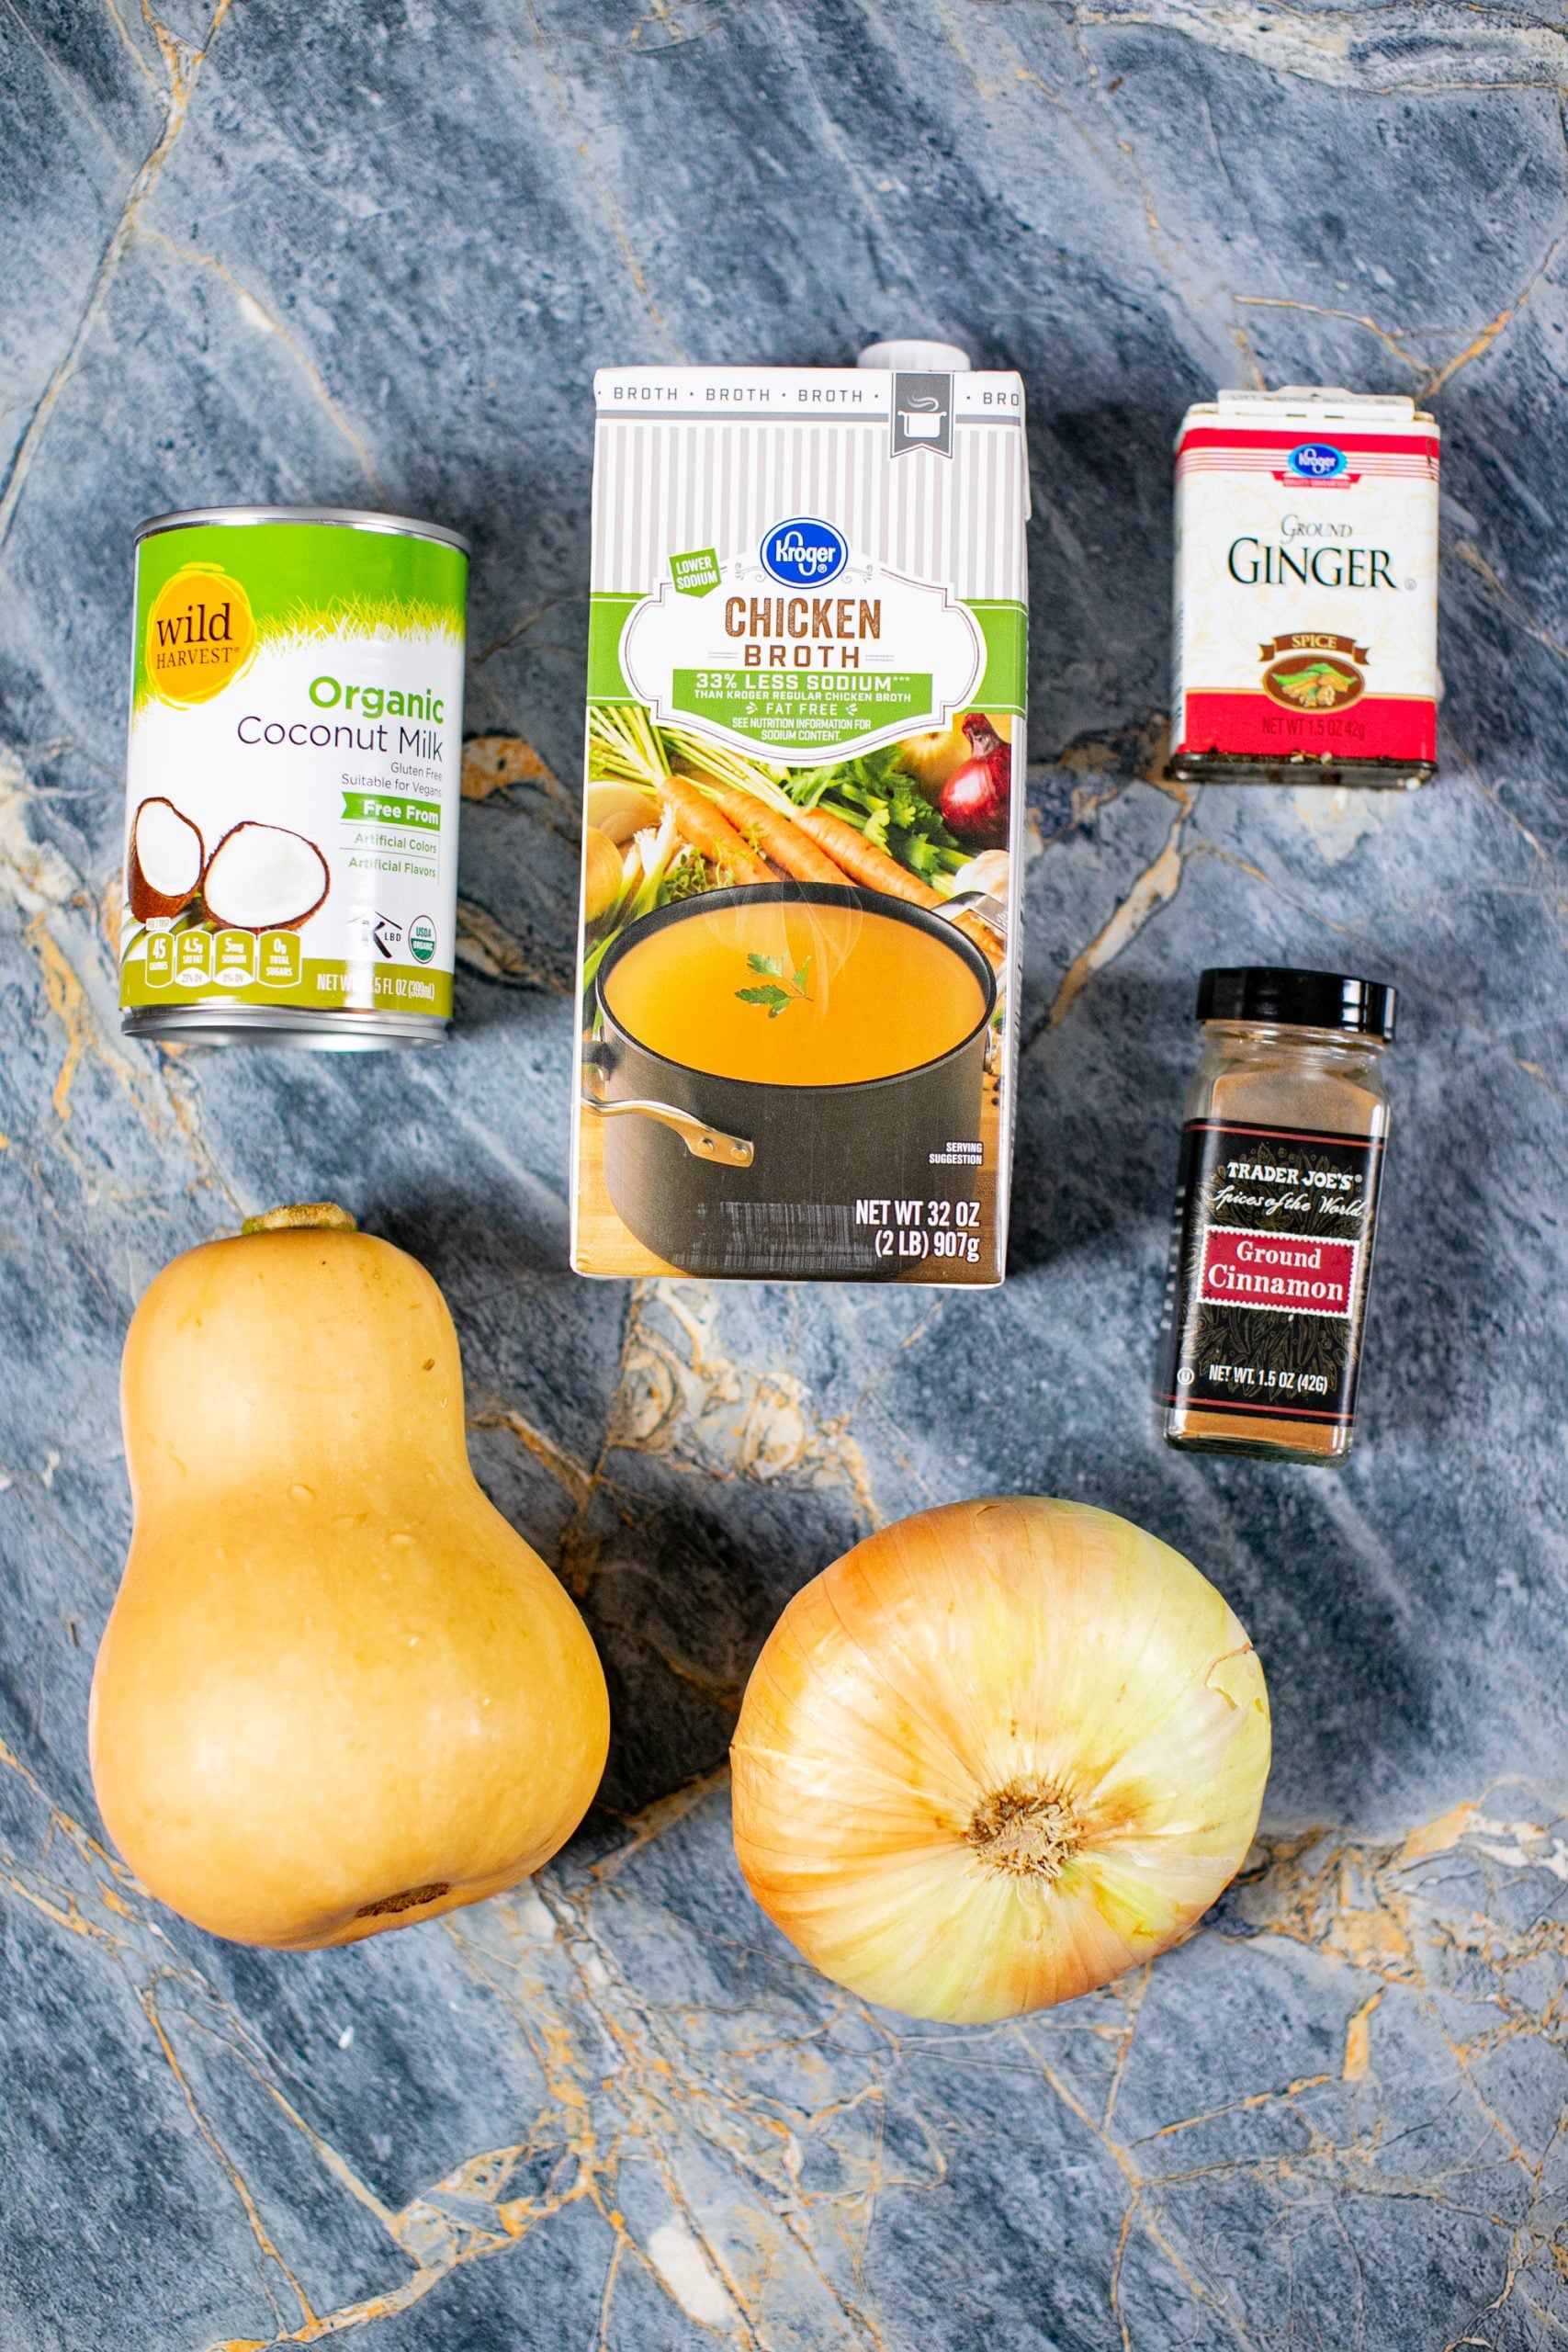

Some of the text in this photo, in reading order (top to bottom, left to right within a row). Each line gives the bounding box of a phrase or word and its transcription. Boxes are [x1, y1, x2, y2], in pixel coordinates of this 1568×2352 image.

[614, 386, 678, 401] BROTH
[705, 388, 771, 401] BROTH
[797, 389, 863, 402] BROTH
[1298, 447, 1337, 474] Kroger
[1280, 514, 1353, 544] GROUND
[775, 530, 836, 576] Kroger
[1227, 537, 1398, 589] GINGER
[676, 556, 713, 575] LOWER
[676, 571, 718, 590] SODIUM
[156, 603, 232, 647] wild
[724, 596, 882, 639] CHICKEN
[1292, 634, 1338, 650] SPICE
[156, 647, 233, 670] HARVEST
[744, 644, 860, 668] BROTH
[695, 673, 738, 689] 33%
[745, 673, 799, 690] LESS
[309, 675, 445, 725] Organic
[694, 690, 911, 703] THAN KROGER REGULAR CHICKEN BROTH
[766, 702, 838, 716] FAT FREE
[732, 718, 872, 730] SEE NUTRITION INFORMATION FOR
[1263, 718, 1366, 741] NET WT 1.5 OZ 42g
[237, 716, 443, 763] Coconut Milk
[761, 730, 841, 742] SODIUM CONTENT.
[390, 762, 443, 782] Gluten Free
[341, 773, 442, 797] Suitable for Vegans
[364, 799, 439, 825] Free From
[355, 832, 436, 854] Artificial Colors
[404, 863, 435, 877] Flavors
[415, 926, 432, 938] USDA
[152, 938, 166, 959] 45
[317, 974, 338, 991] NET
[383, 978, 393, 995] FL
[395, 979, 407, 996] OZ
[929, 1153, 983, 1165] SUGGESTION
[946, 1142, 983, 1153] SERVING
[1227, 1161, 1354, 1191] TRADER JOE'S
[1206, 1184, 1367, 1218] Spices of the World
[855, 1200, 981, 1227] NET WT 32 OZ
[874, 1230, 980, 1262] (2 LB) 907g
[1235, 1240, 1322, 1270] Ground
[1207, 1262, 1344, 1301] Cinnamon
[1209, 1364, 1328, 1395] NET WT. 1.5 OZ (42G)
